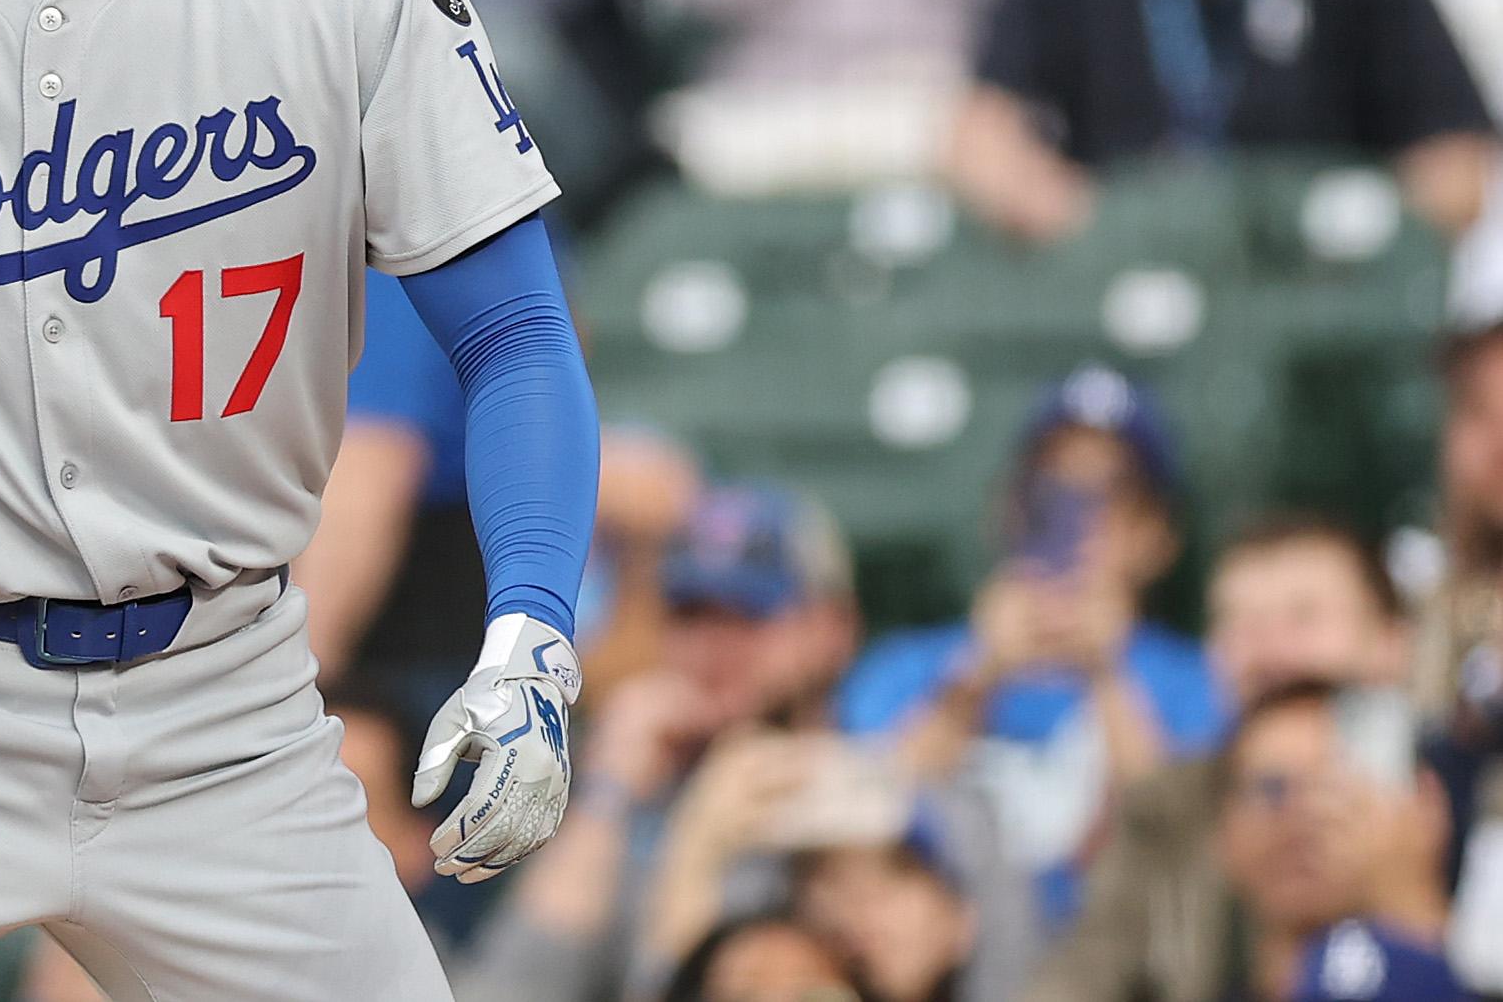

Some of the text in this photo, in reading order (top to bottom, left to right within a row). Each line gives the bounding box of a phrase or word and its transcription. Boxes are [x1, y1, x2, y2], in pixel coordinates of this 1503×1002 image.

[159, 251, 305, 422] 17
[470, 748, 518, 825] new balance
